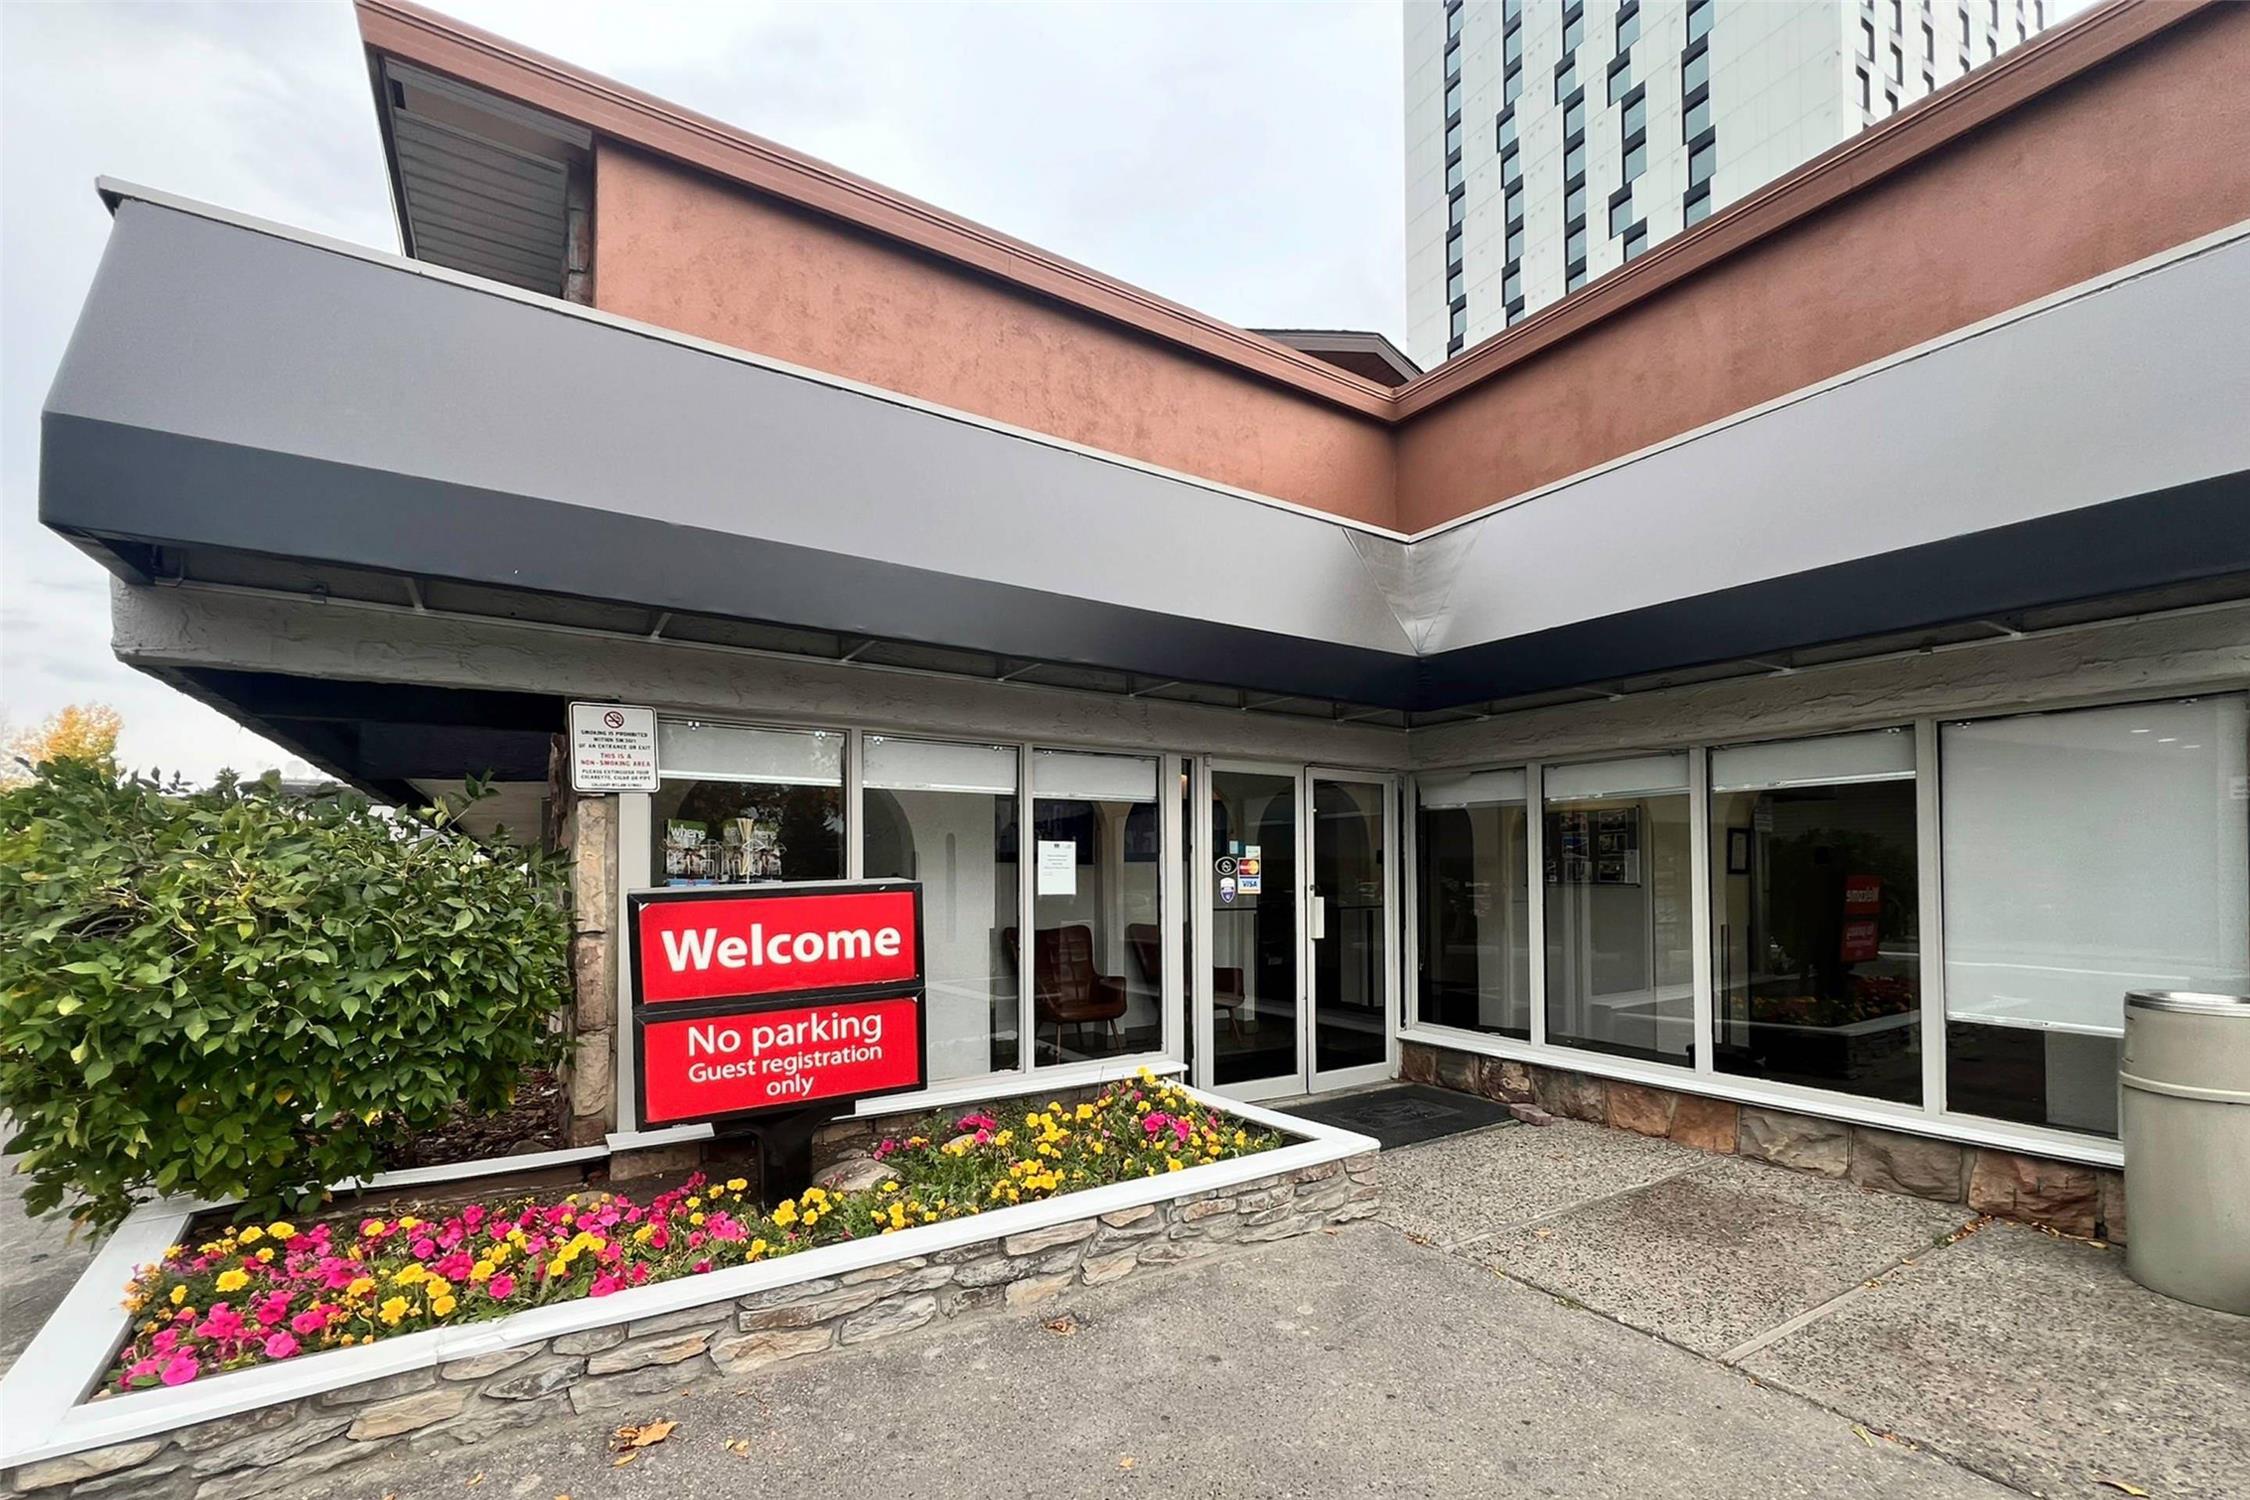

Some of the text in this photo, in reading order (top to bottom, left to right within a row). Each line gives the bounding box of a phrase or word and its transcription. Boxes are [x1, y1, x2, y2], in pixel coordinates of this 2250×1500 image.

[670, 824, 706, 840] where
[660, 923, 901, 972] Welcome
[688, 1012, 883, 1056] No parking
[688, 1045, 882, 1082] Guest registration
[766, 1076, 814, 1096] only
